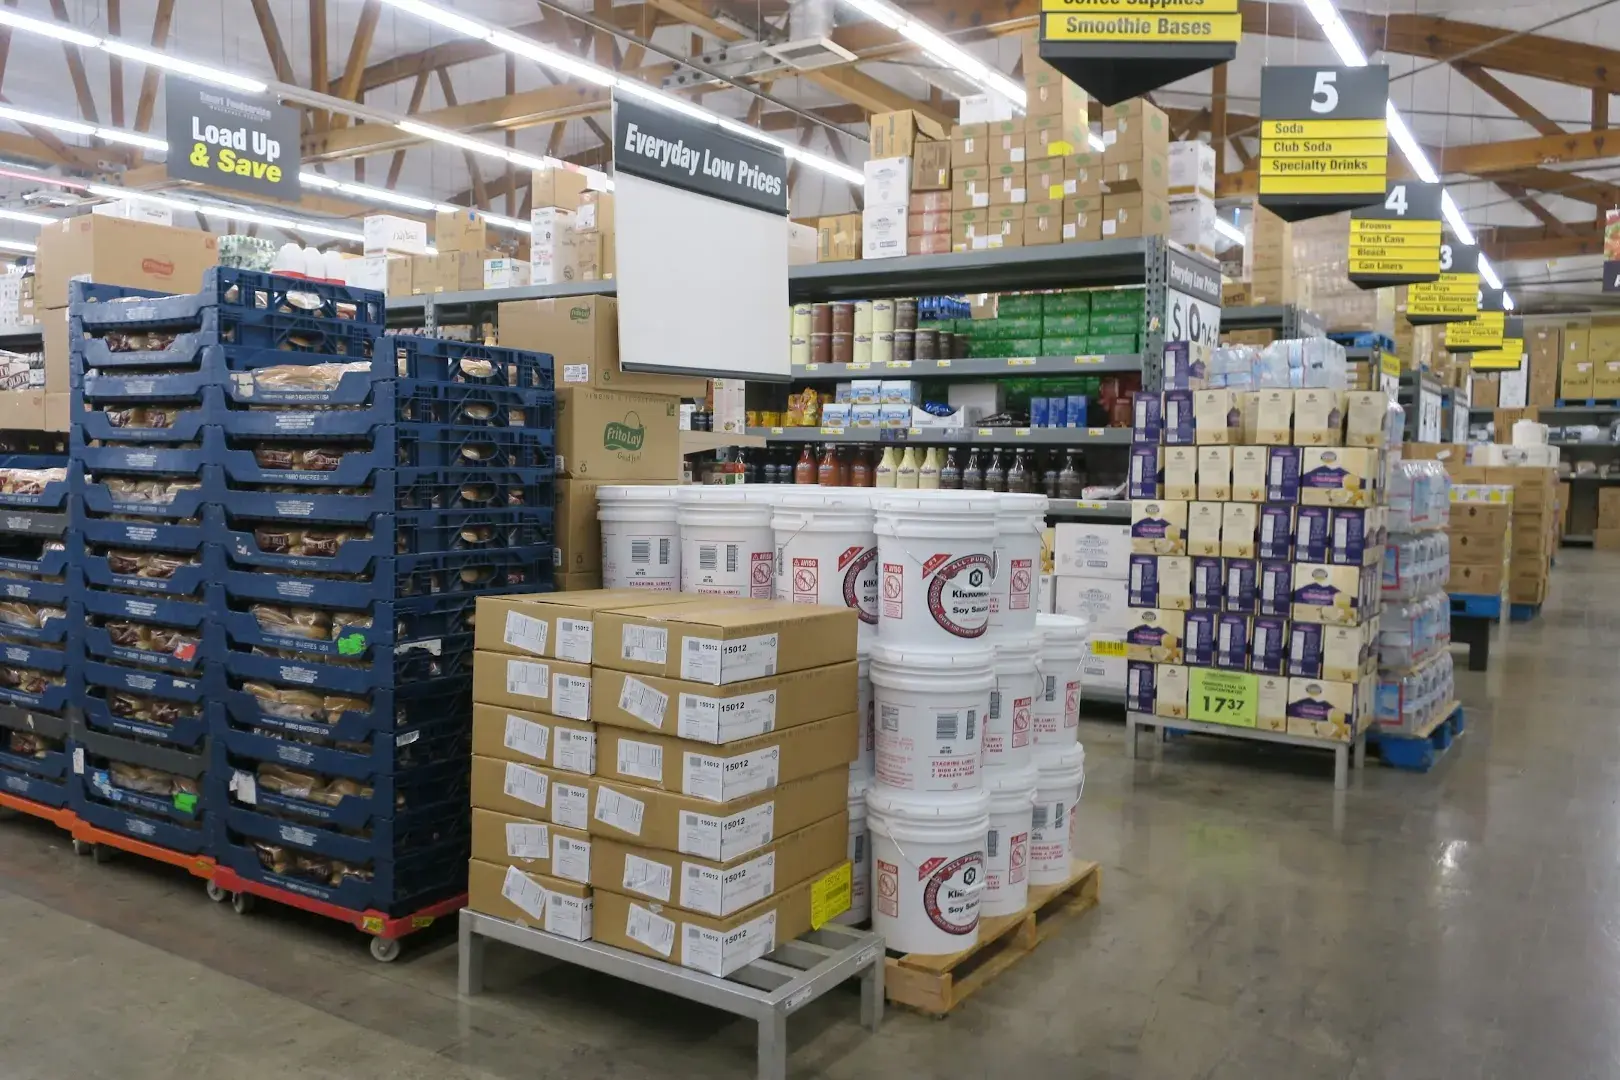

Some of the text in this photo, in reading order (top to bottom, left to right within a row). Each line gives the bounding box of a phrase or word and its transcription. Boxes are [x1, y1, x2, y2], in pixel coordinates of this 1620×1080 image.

[1066, 16, 1212, 35] Smoothie Bases
[1311, 72, 1338, 114] 5
[1275, 123, 1304, 134] Soda
[192, 116, 280, 162] Load Up
[1274, 142, 1332, 152] Club Soda
[190, 143, 282, 182] & Save
[624, 122, 782, 196] Everyday Low Prices
[1272, 160, 1368, 172] Specialty Drinks
[1384, 185, 1408, 216] 4
[1360, 235, 1405, 244] Trash Cans
[1358, 248, 1386, 256] Bleach
[1440, 244, 1452, 270] 3
[1358, 262, 1403, 270] Can Liners
[1171, 260, 1218, 296] Everyday Low Prices
[724, 644, 747, 654] 15012
[721, 702, 745, 712] 15012
[1204, 696, 1245, 713] 17 37
[725, 759, 749, 772] 15012
[724, 817, 745, 830] 15012
[725, 869, 746, 883] 15012
[702, 933, 719, 942] 15012
[725, 930, 747, 945] 15012
